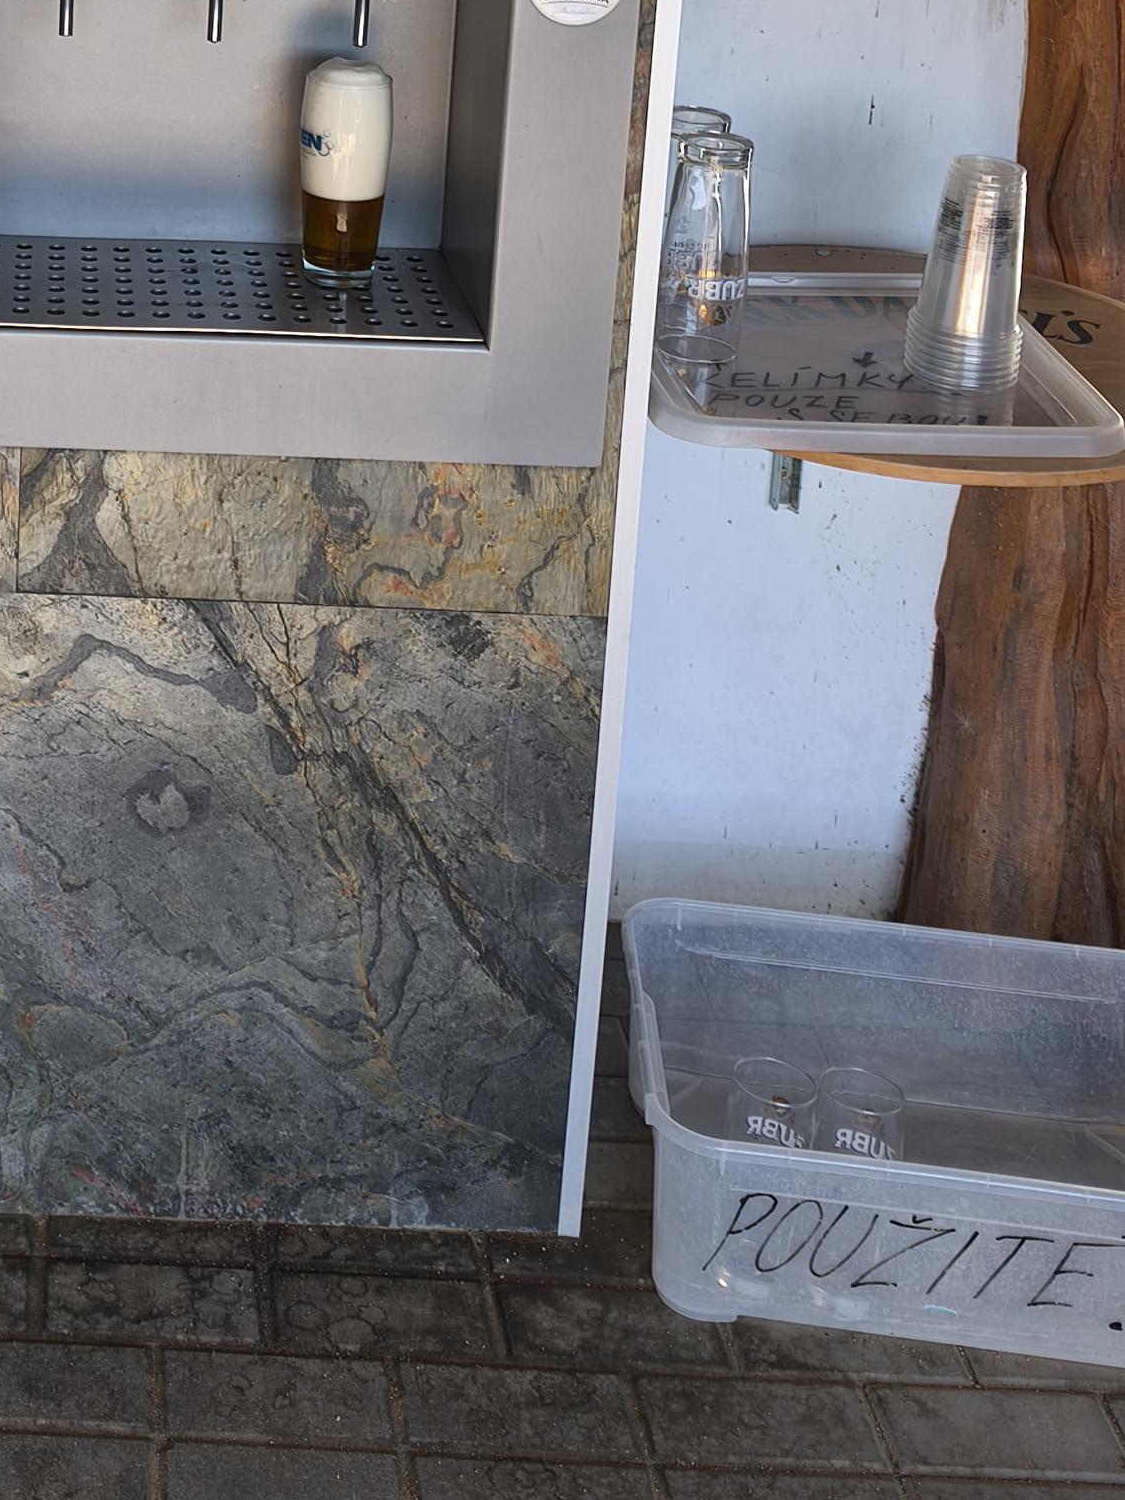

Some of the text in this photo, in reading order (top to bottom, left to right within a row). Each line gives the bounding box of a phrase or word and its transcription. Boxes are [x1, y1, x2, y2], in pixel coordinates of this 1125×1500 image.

[300, 128, 322, 151] EN
[711, 393, 860, 410] POUZE
[702, 1192, 1125, 1309] POUŽITE
